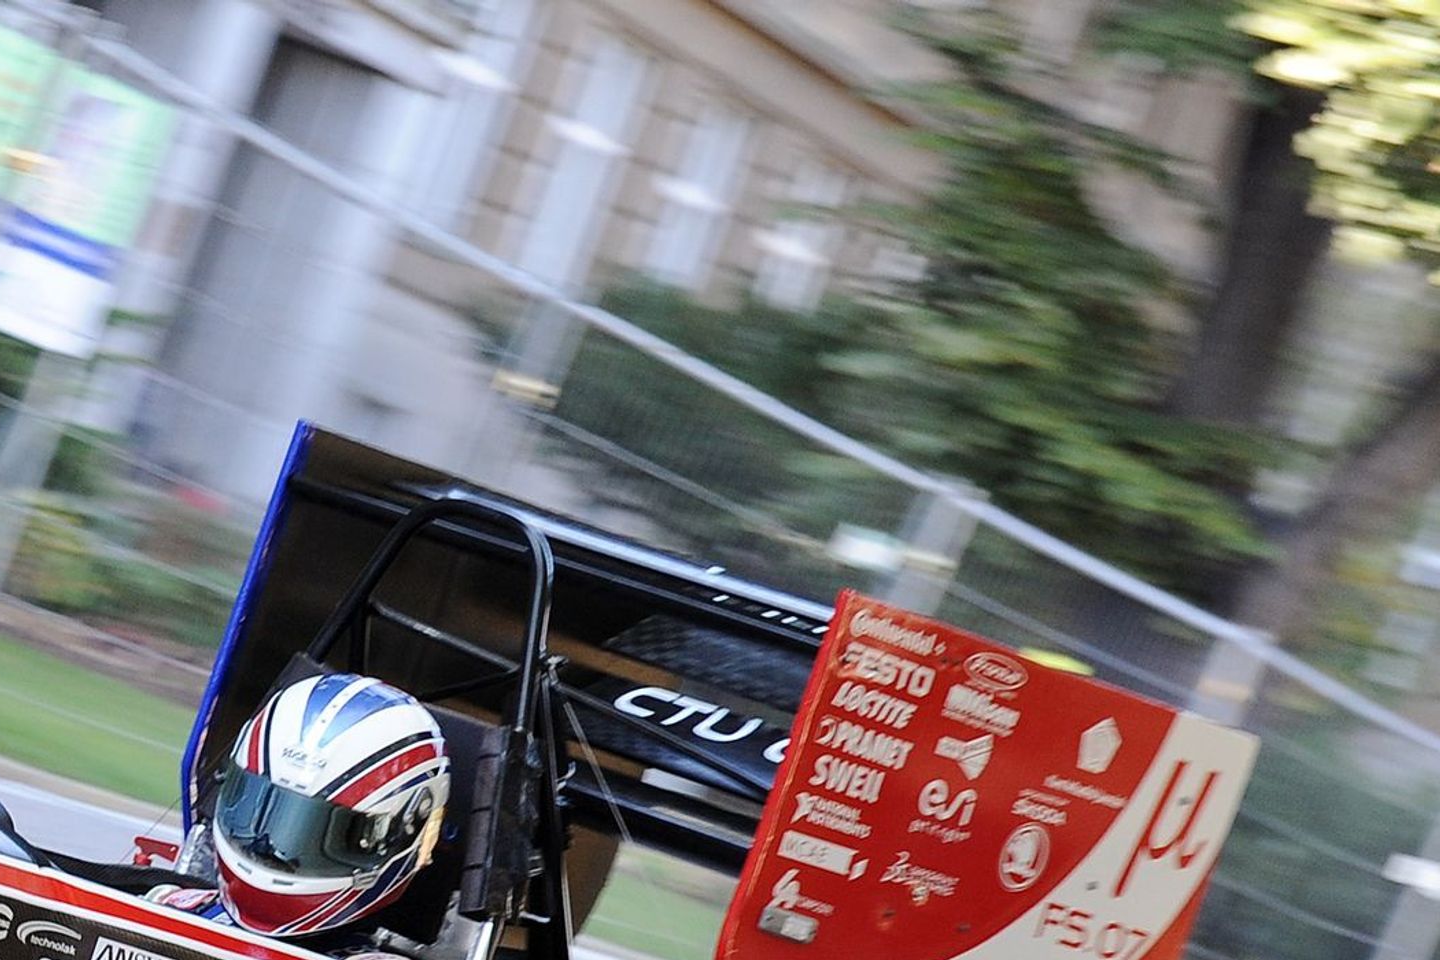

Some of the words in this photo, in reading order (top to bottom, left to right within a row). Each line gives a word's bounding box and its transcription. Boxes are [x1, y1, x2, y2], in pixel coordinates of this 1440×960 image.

[841, 641, 936, 698] FESTO
[613, 686, 763, 743] CTU
[831, 681, 918, 729] LOCTITE
[832, 719, 915, 770] PRAMET
[918, 779, 979, 827] esi
[30, 934, 77, 956] technolak
